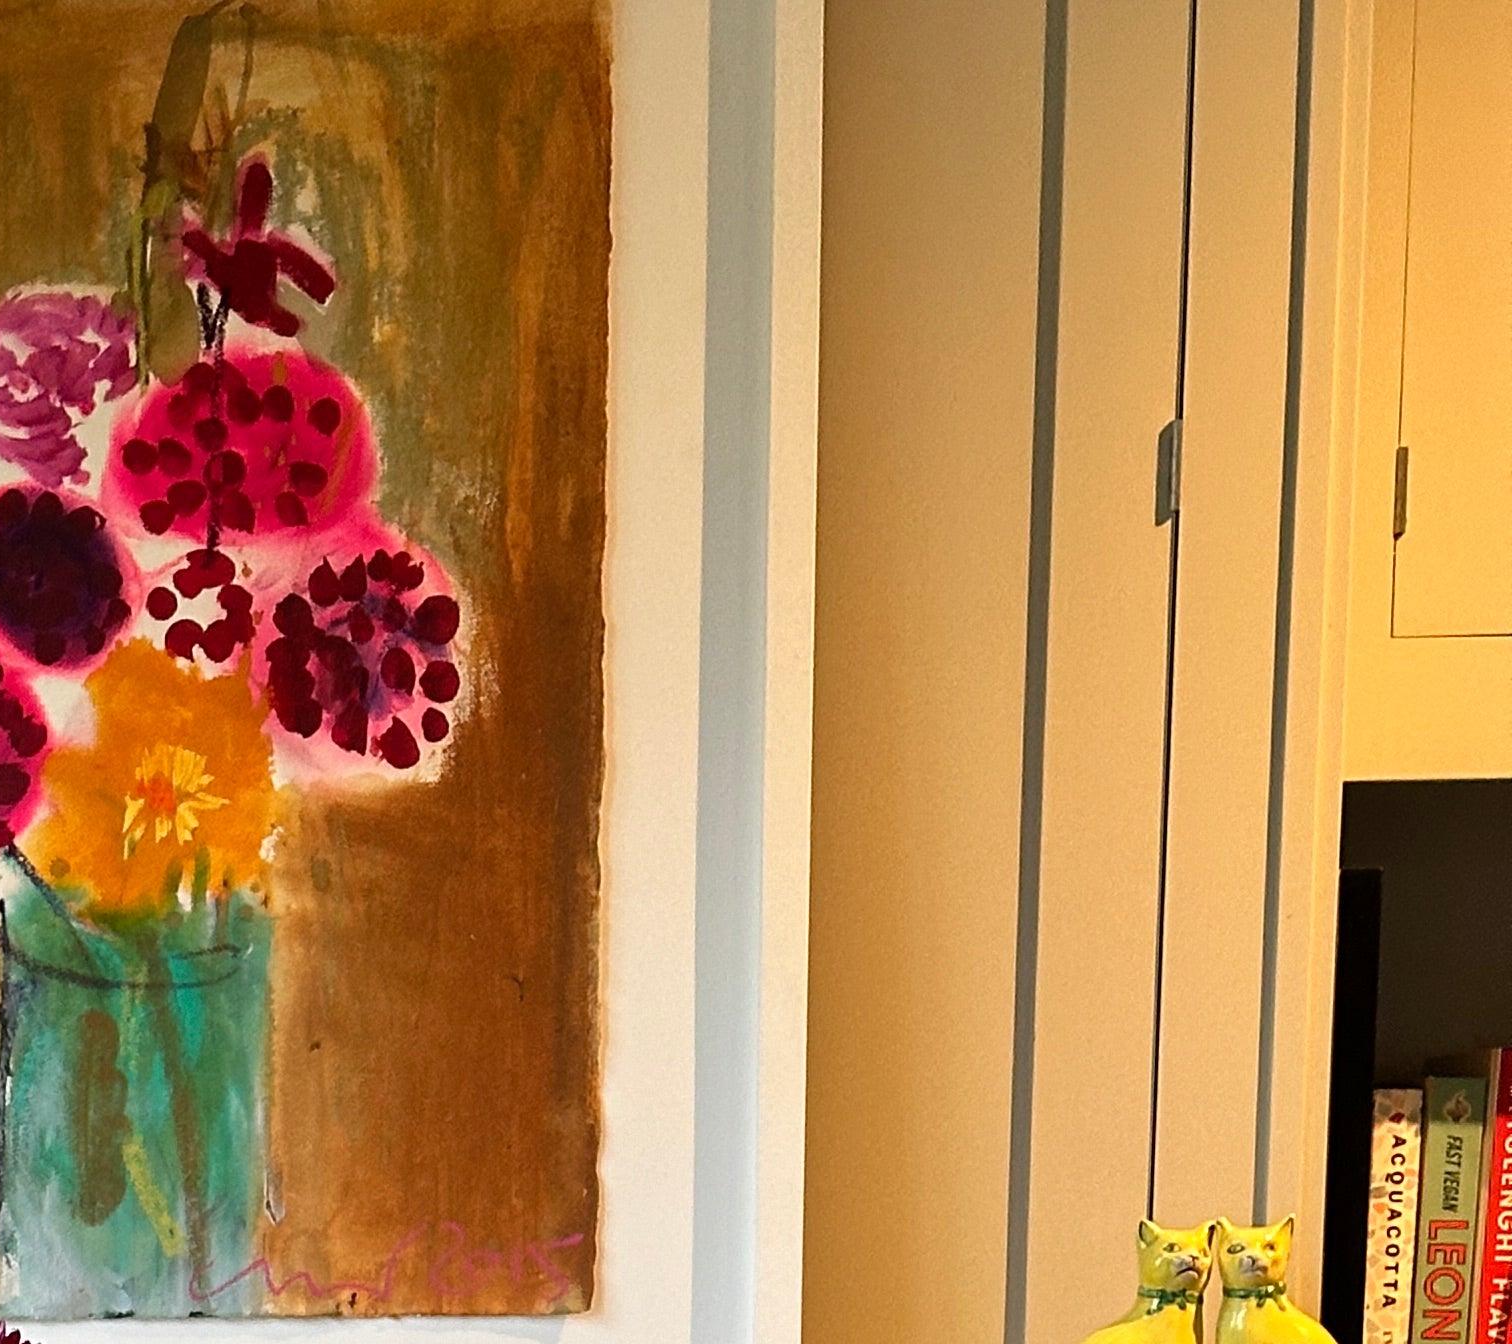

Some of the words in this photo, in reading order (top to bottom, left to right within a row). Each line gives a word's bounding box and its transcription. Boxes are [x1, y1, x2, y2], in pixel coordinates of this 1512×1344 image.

[1441, 1171, 1461, 1213] VEGAN
[1445, 1135, 1463, 1168] FAST
[1382, 1134, 1407, 1308] ACQUACOTTA
[1420, 1219, 1469, 1341] LEON
